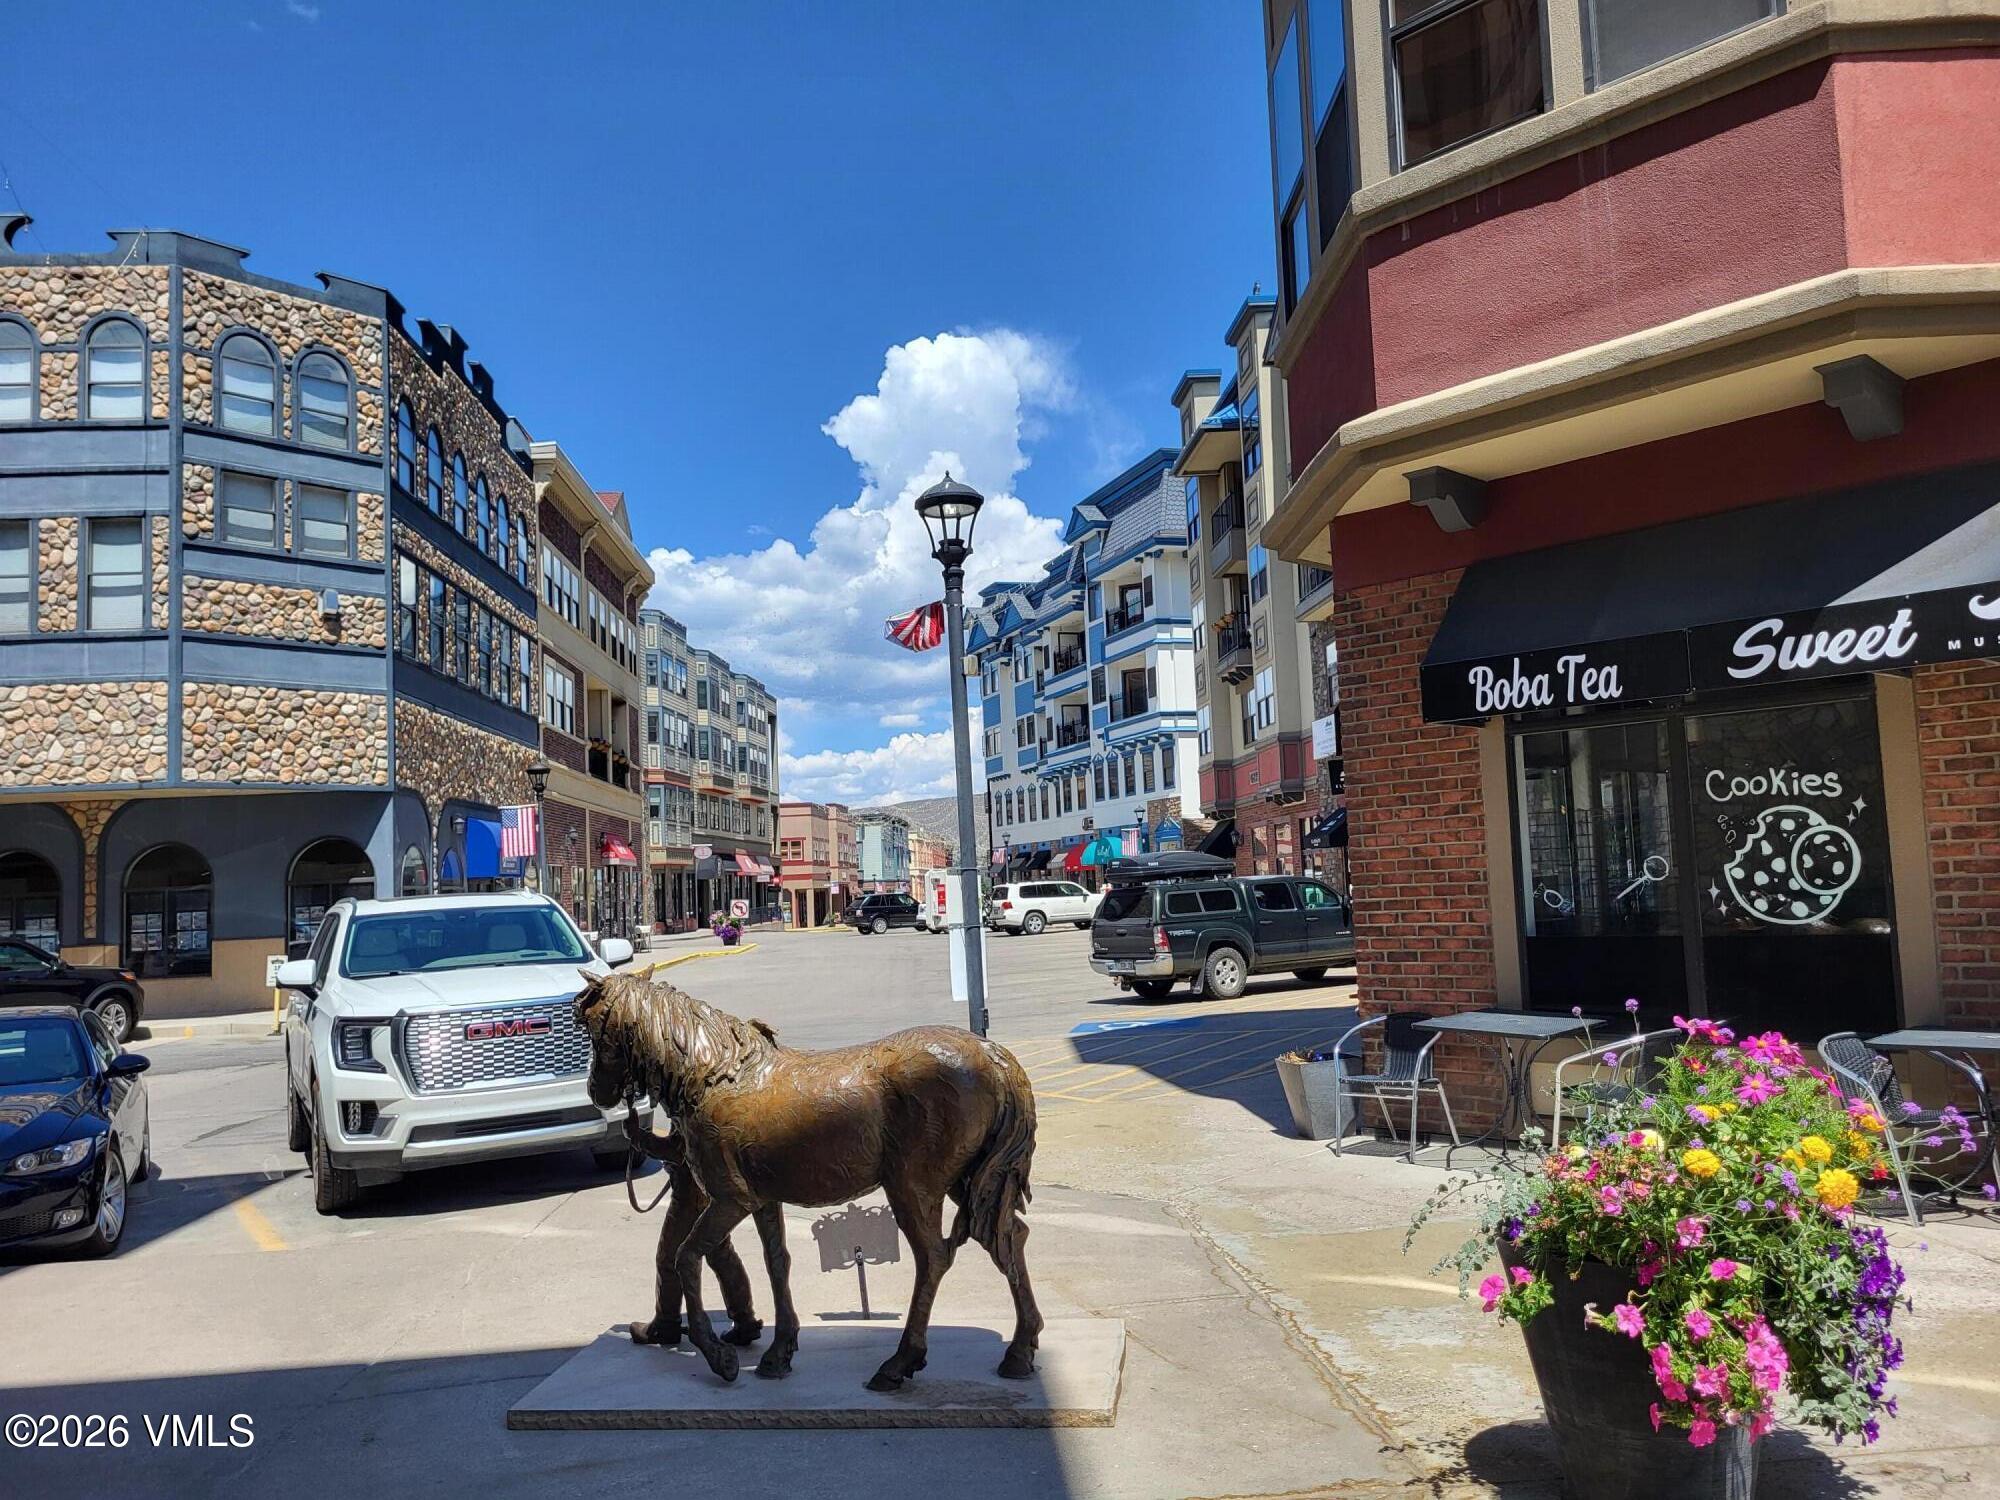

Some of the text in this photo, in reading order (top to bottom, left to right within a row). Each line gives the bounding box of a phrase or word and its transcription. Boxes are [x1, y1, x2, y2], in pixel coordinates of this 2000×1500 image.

[1726, 608, 1919, 679] Sweet
[1947, 634, 2000, 651] MU
[1468, 653, 1623, 712] Boba Tea
[467, 1017, 551, 1040] GMC
